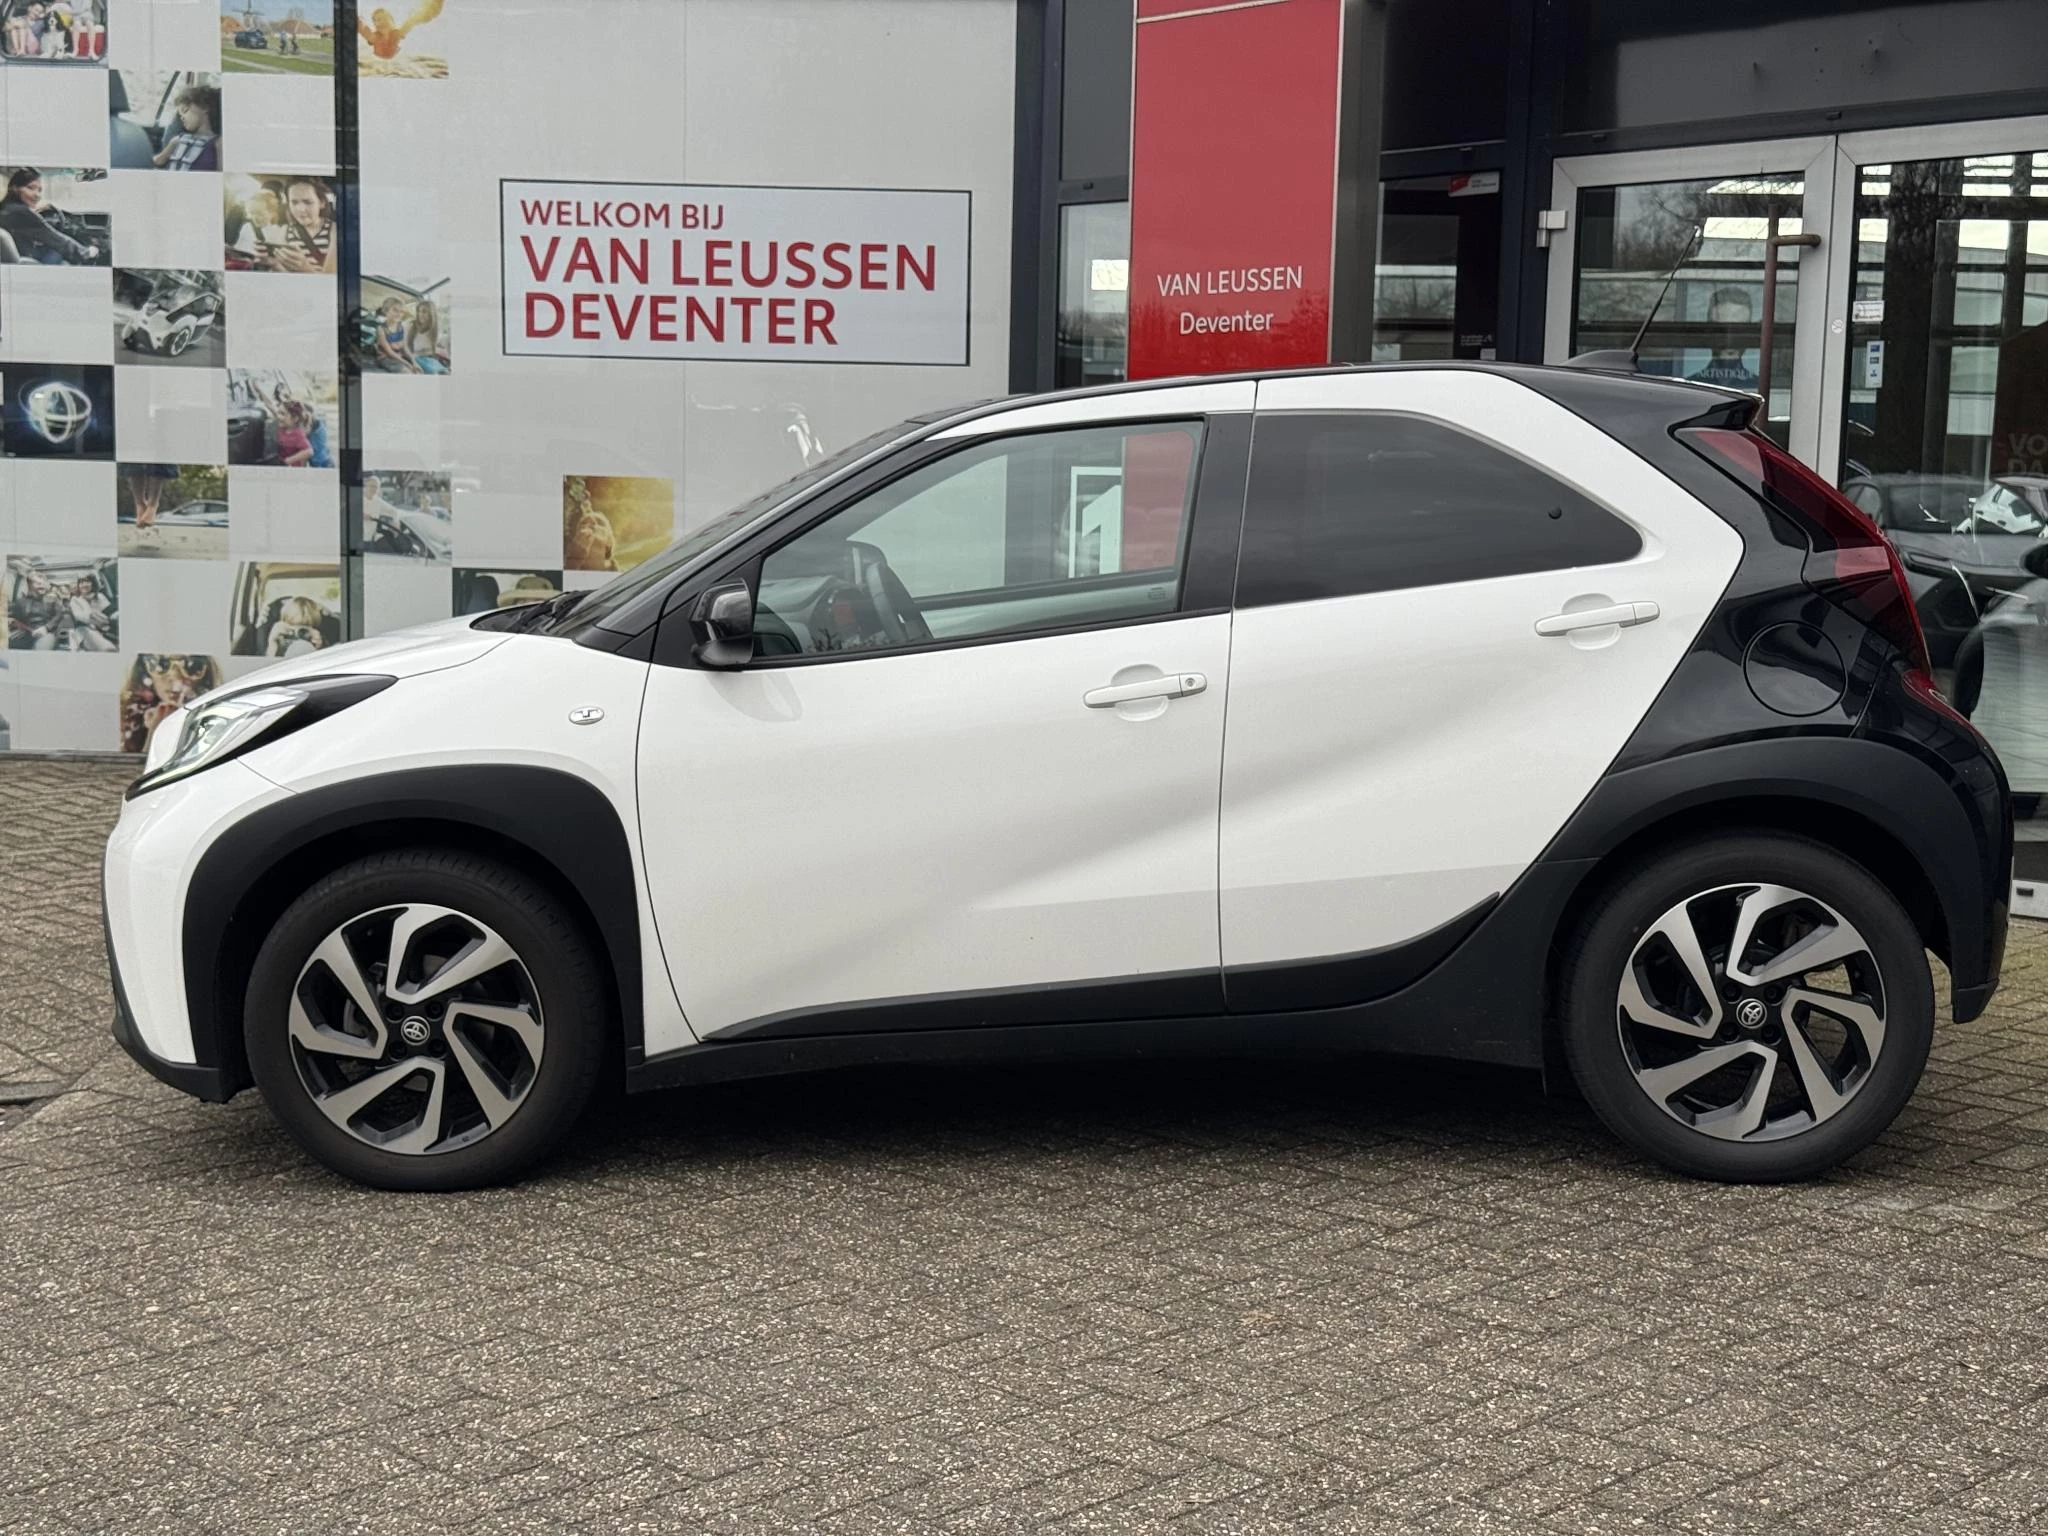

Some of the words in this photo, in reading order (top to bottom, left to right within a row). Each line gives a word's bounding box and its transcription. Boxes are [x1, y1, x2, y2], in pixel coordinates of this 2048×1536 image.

[521, 200, 671, 228] WELKOM
[681, 204, 724, 230] BIJ
[520, 235, 650, 285] VAN
[672, 239, 936, 291] LEUSSEN
[1157, 272, 1201, 297] VAN
[1207, 265, 1303, 294] LEUSSEN
[524, 292, 839, 346] DEVENTER
[1180, 310, 1274, 335] Deventer
